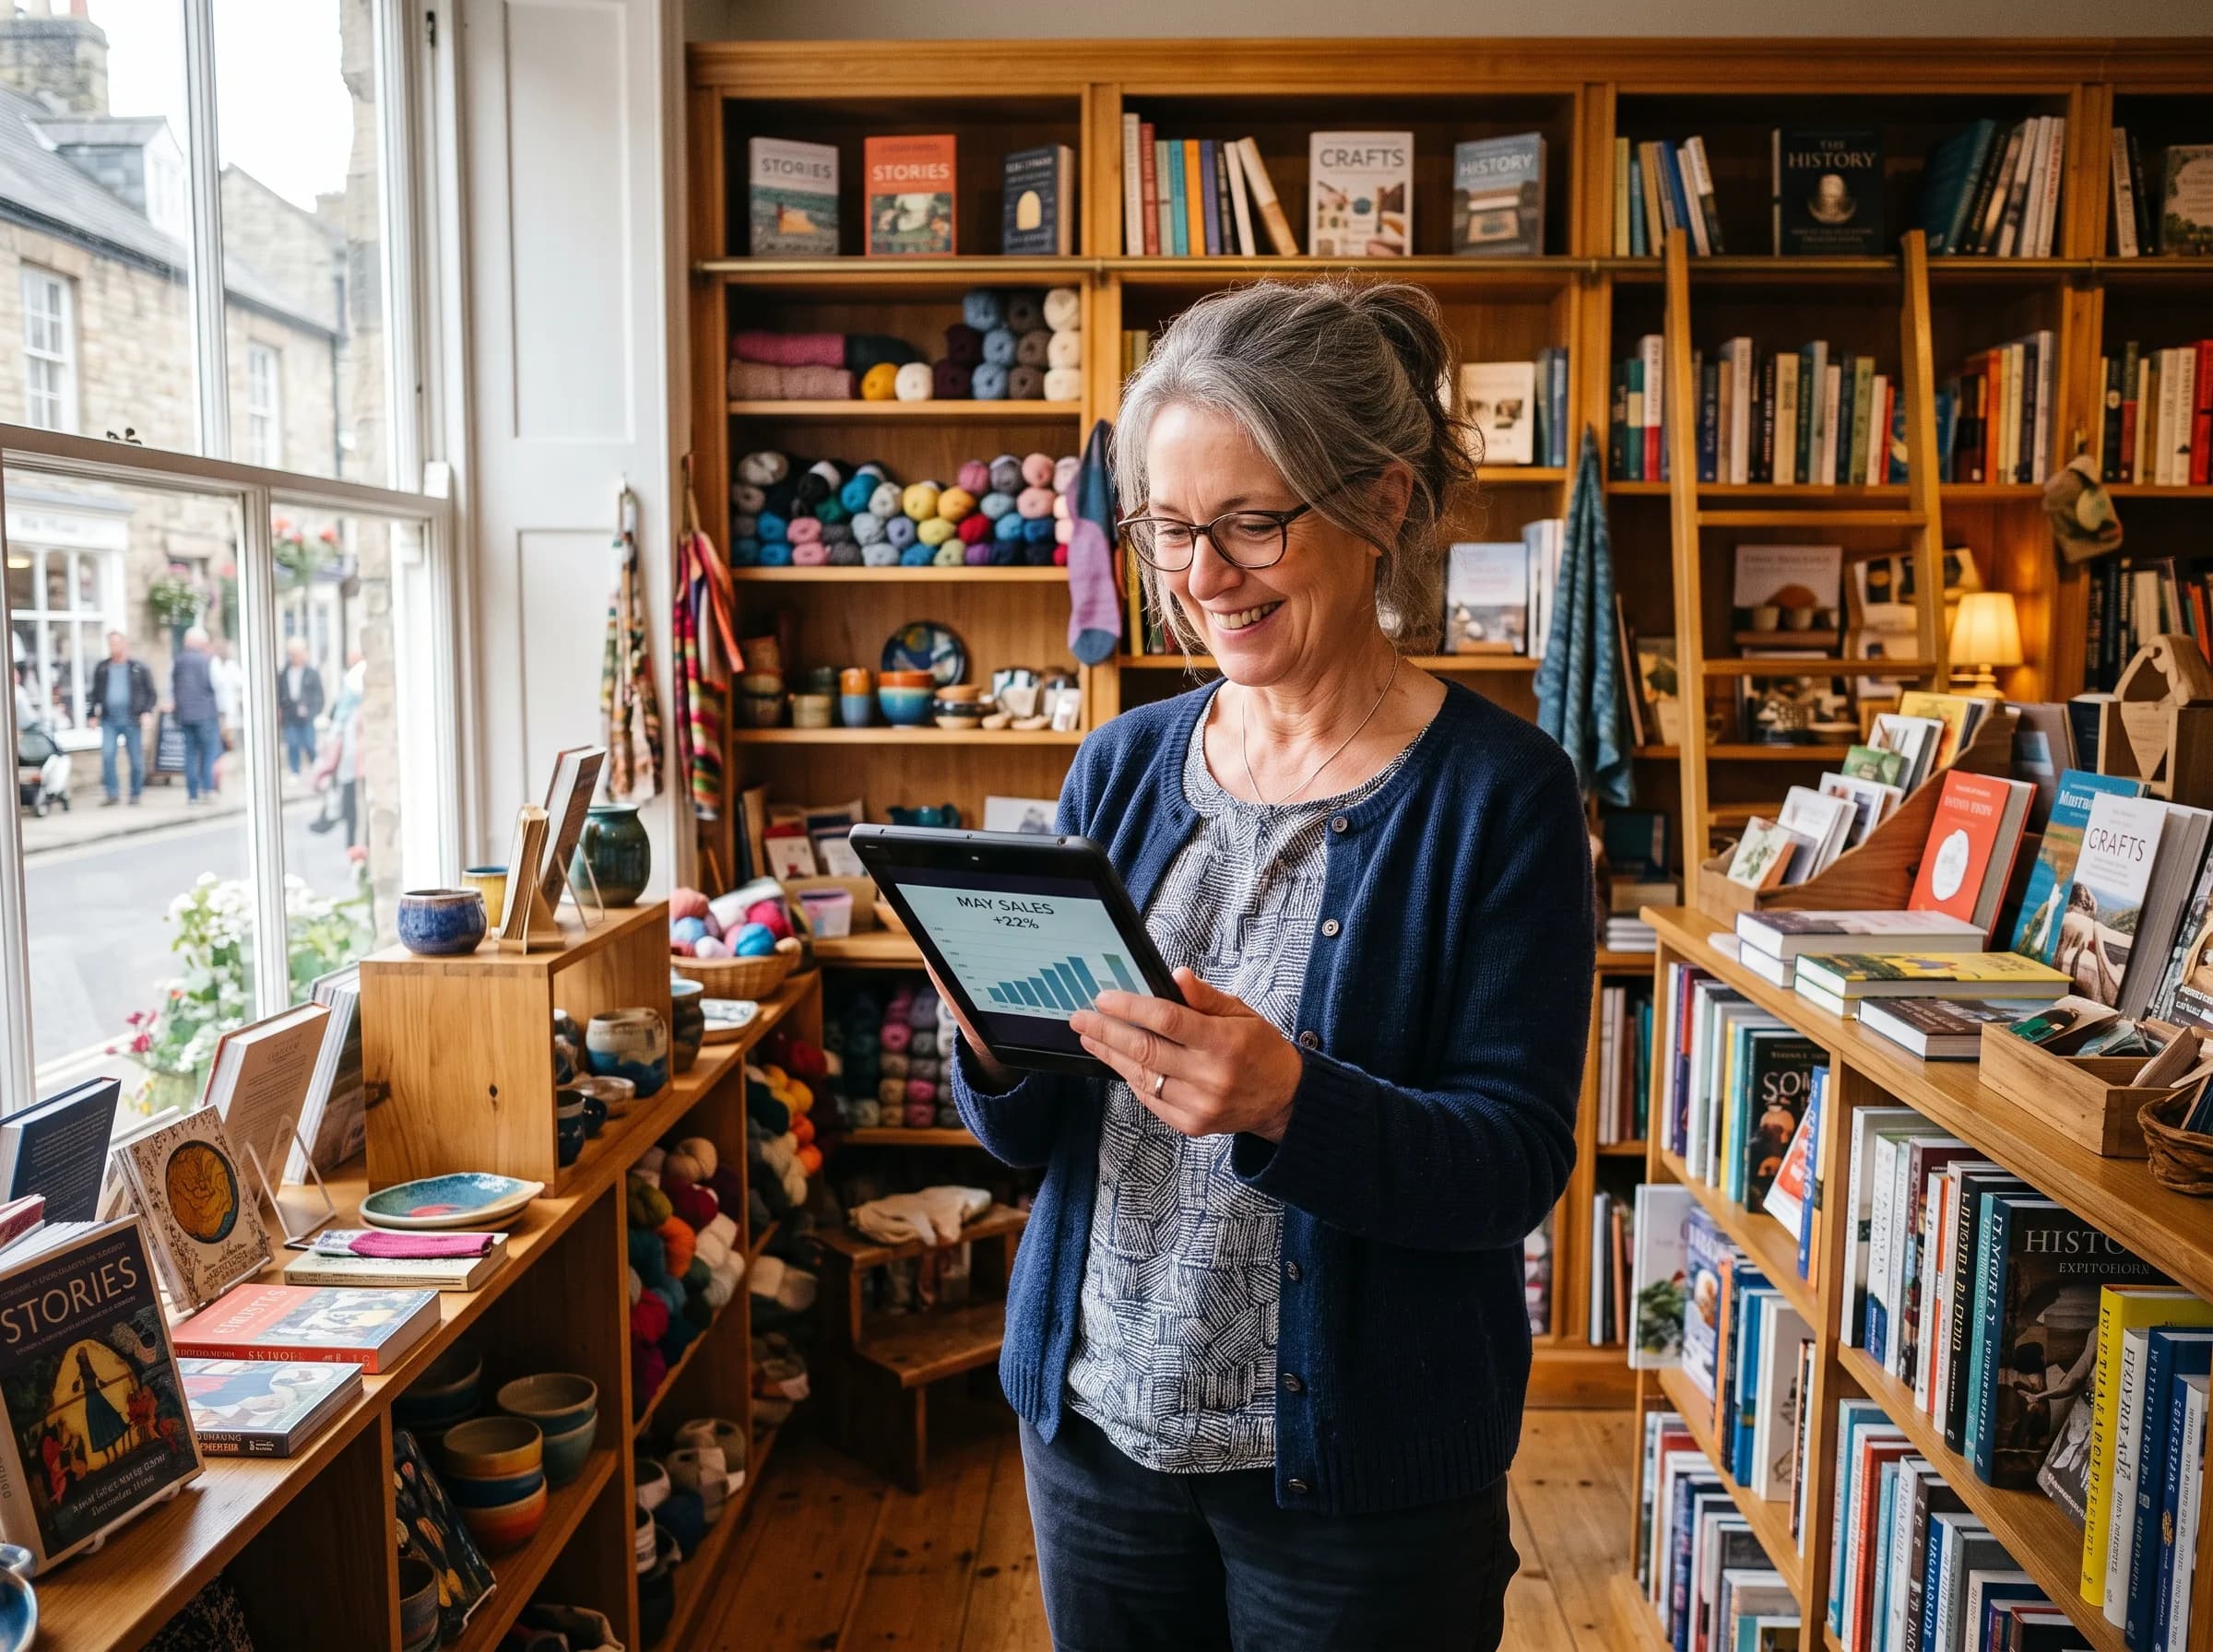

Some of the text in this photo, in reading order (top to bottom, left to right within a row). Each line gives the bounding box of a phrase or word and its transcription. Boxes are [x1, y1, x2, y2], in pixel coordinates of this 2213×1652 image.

[1320, 148, 1405, 168] CRAFTS
[1460, 153, 1534, 177] HISTORY
[1788, 152, 1876, 169] HISTORY
[762, 157, 834, 180] STORIES
[872, 162, 951, 182] STORIES
[2089, 827, 2147, 862] CRAFTS
[956, 896, 1055, 914] MAY SALES
[992, 915, 1040, 929] +22%
[1, 1256, 137, 1344] STORIES
